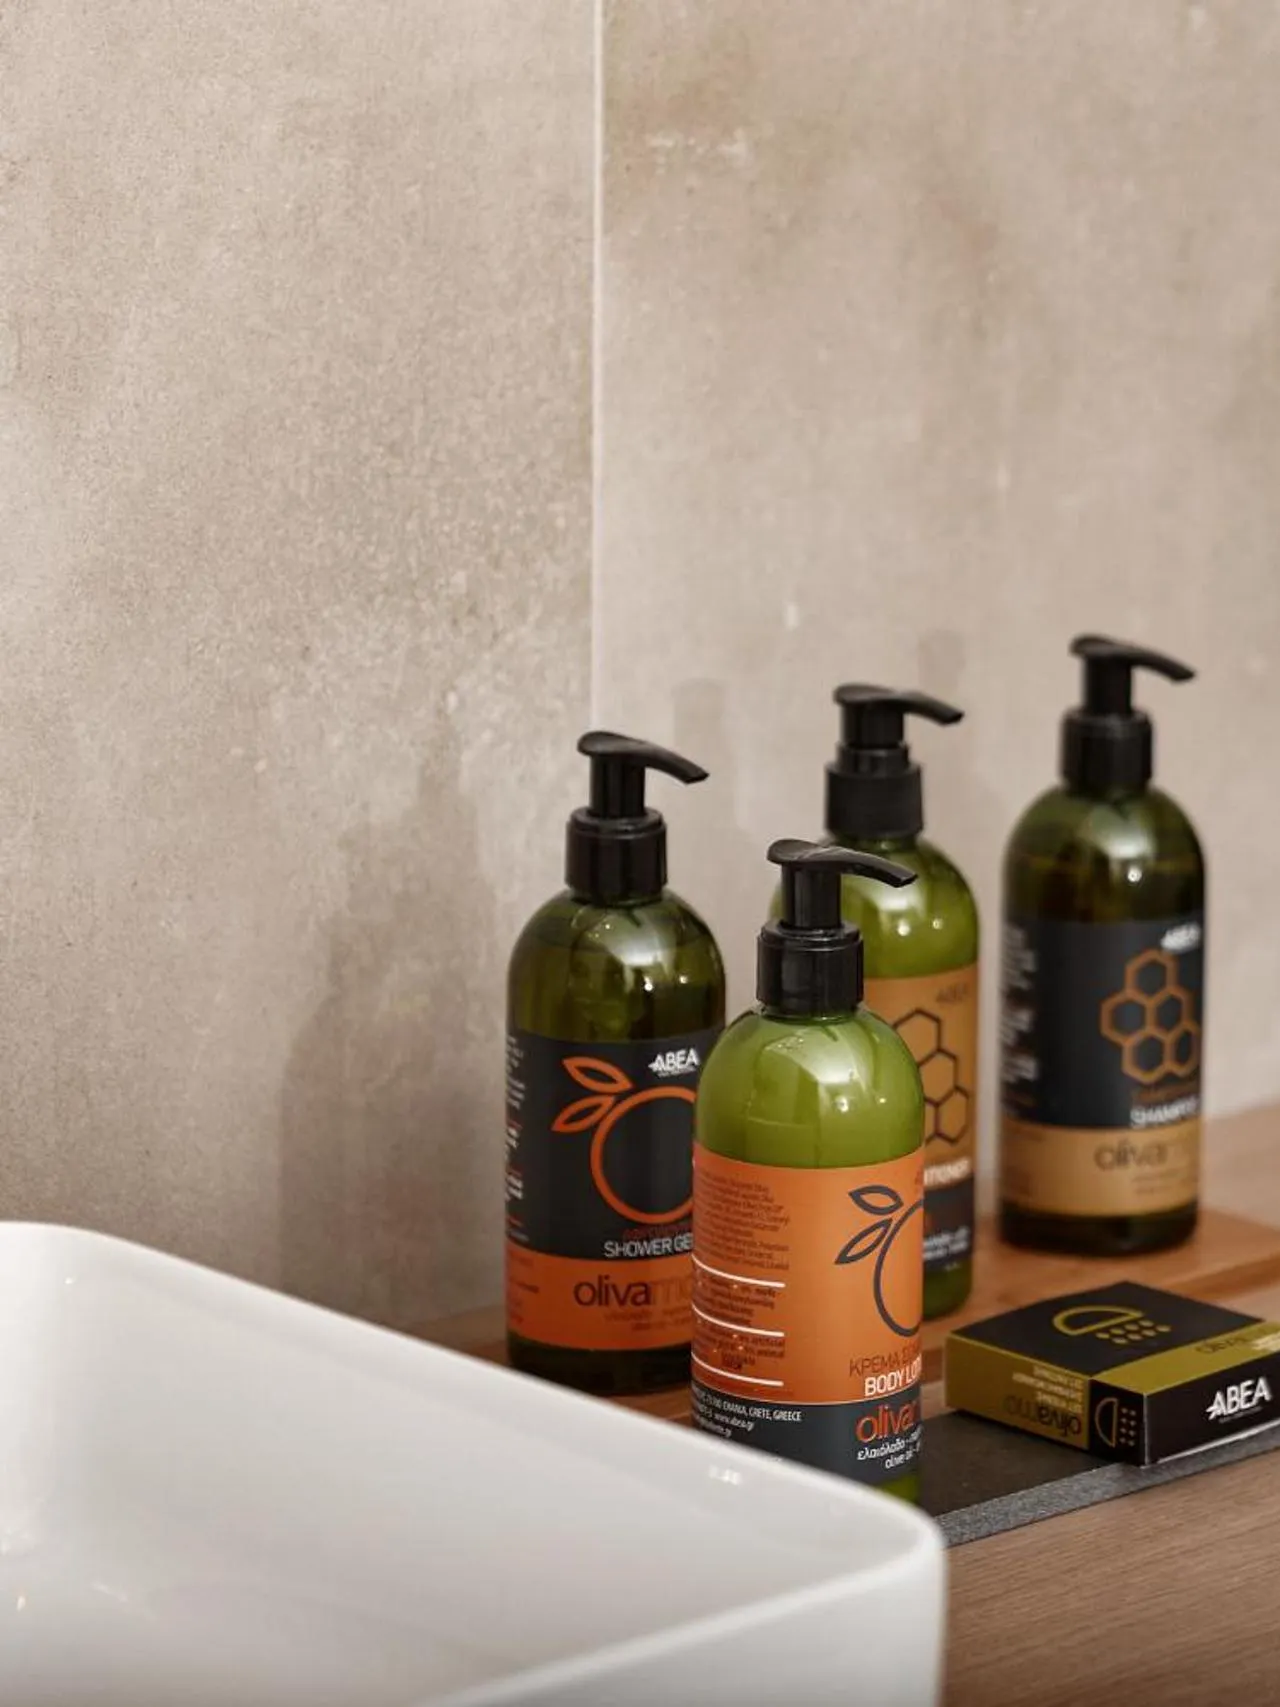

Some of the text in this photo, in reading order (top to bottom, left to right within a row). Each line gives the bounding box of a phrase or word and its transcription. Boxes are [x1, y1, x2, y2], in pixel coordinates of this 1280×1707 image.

[648, 1048, 700, 1072] ABEA
[603, 1237, 673, 1258] SHOWER
[674, 1231, 694, 1252] GE
[864, 1368, 904, 1397] BODY
[1206, 1376, 1272, 1420] ABEA
[772, 1409, 802, 1422] GREECE
[855, 1402, 921, 1443] oliva
